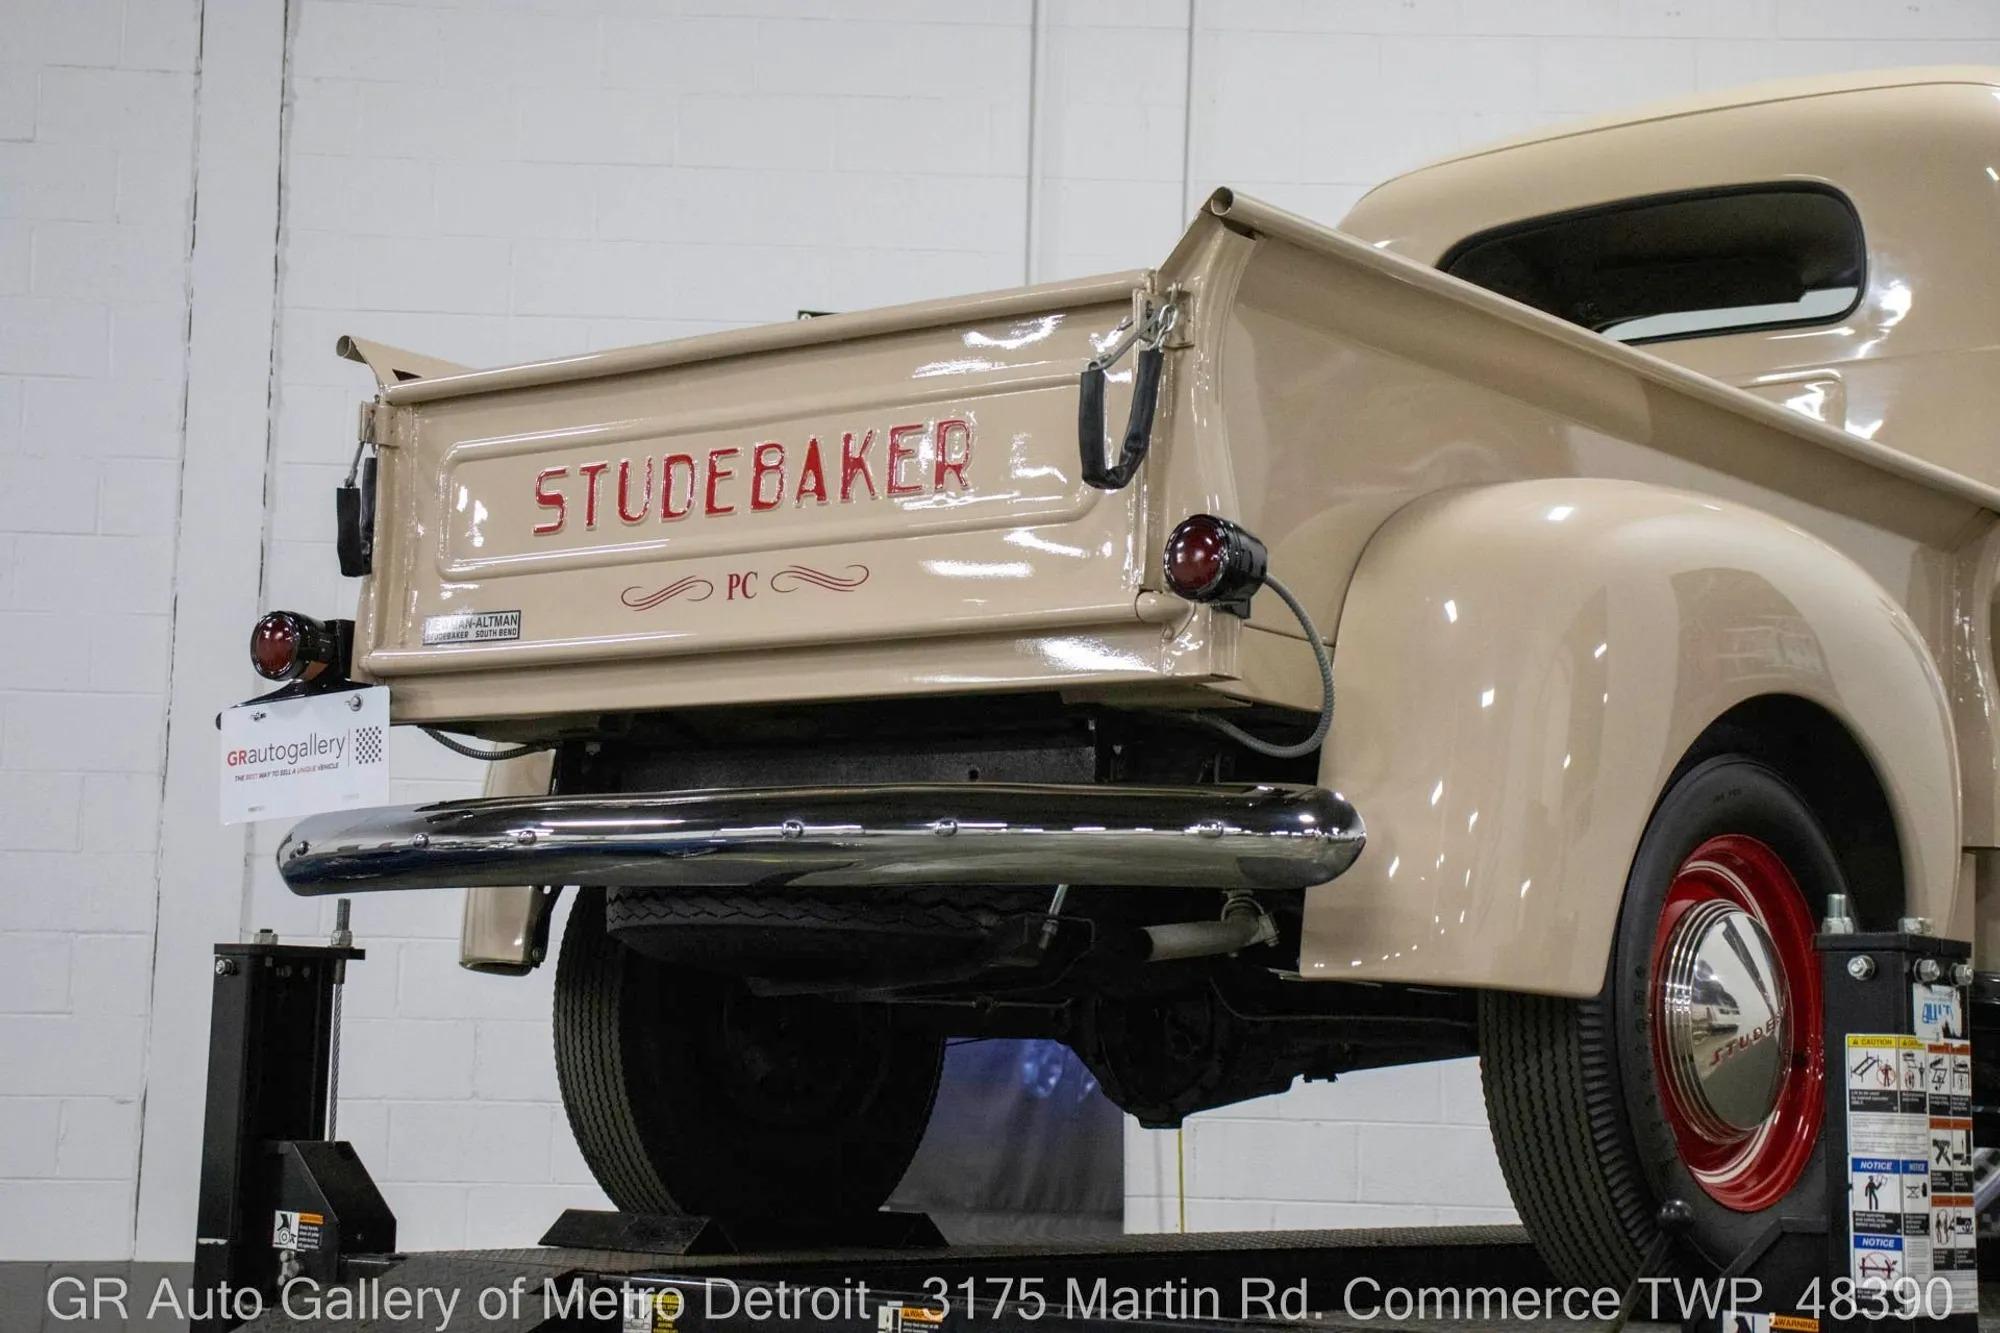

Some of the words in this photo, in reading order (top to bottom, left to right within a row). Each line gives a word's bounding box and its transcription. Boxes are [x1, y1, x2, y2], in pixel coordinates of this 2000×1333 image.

[532, 418, 976, 535] STUDEBAKER
[726, 571, 759, 600] PC
[425, 630, 469, 641] UDEBAKER
[475, 629, 497, 638] SOUTH
[227, 733, 346, 767] GRautogallery
[1860, 1161, 1893, 1170] NOTICE
[1862, 1238, 1895, 1247] NOTICE
[1777, 1317, 1818, 1329] WARNING
